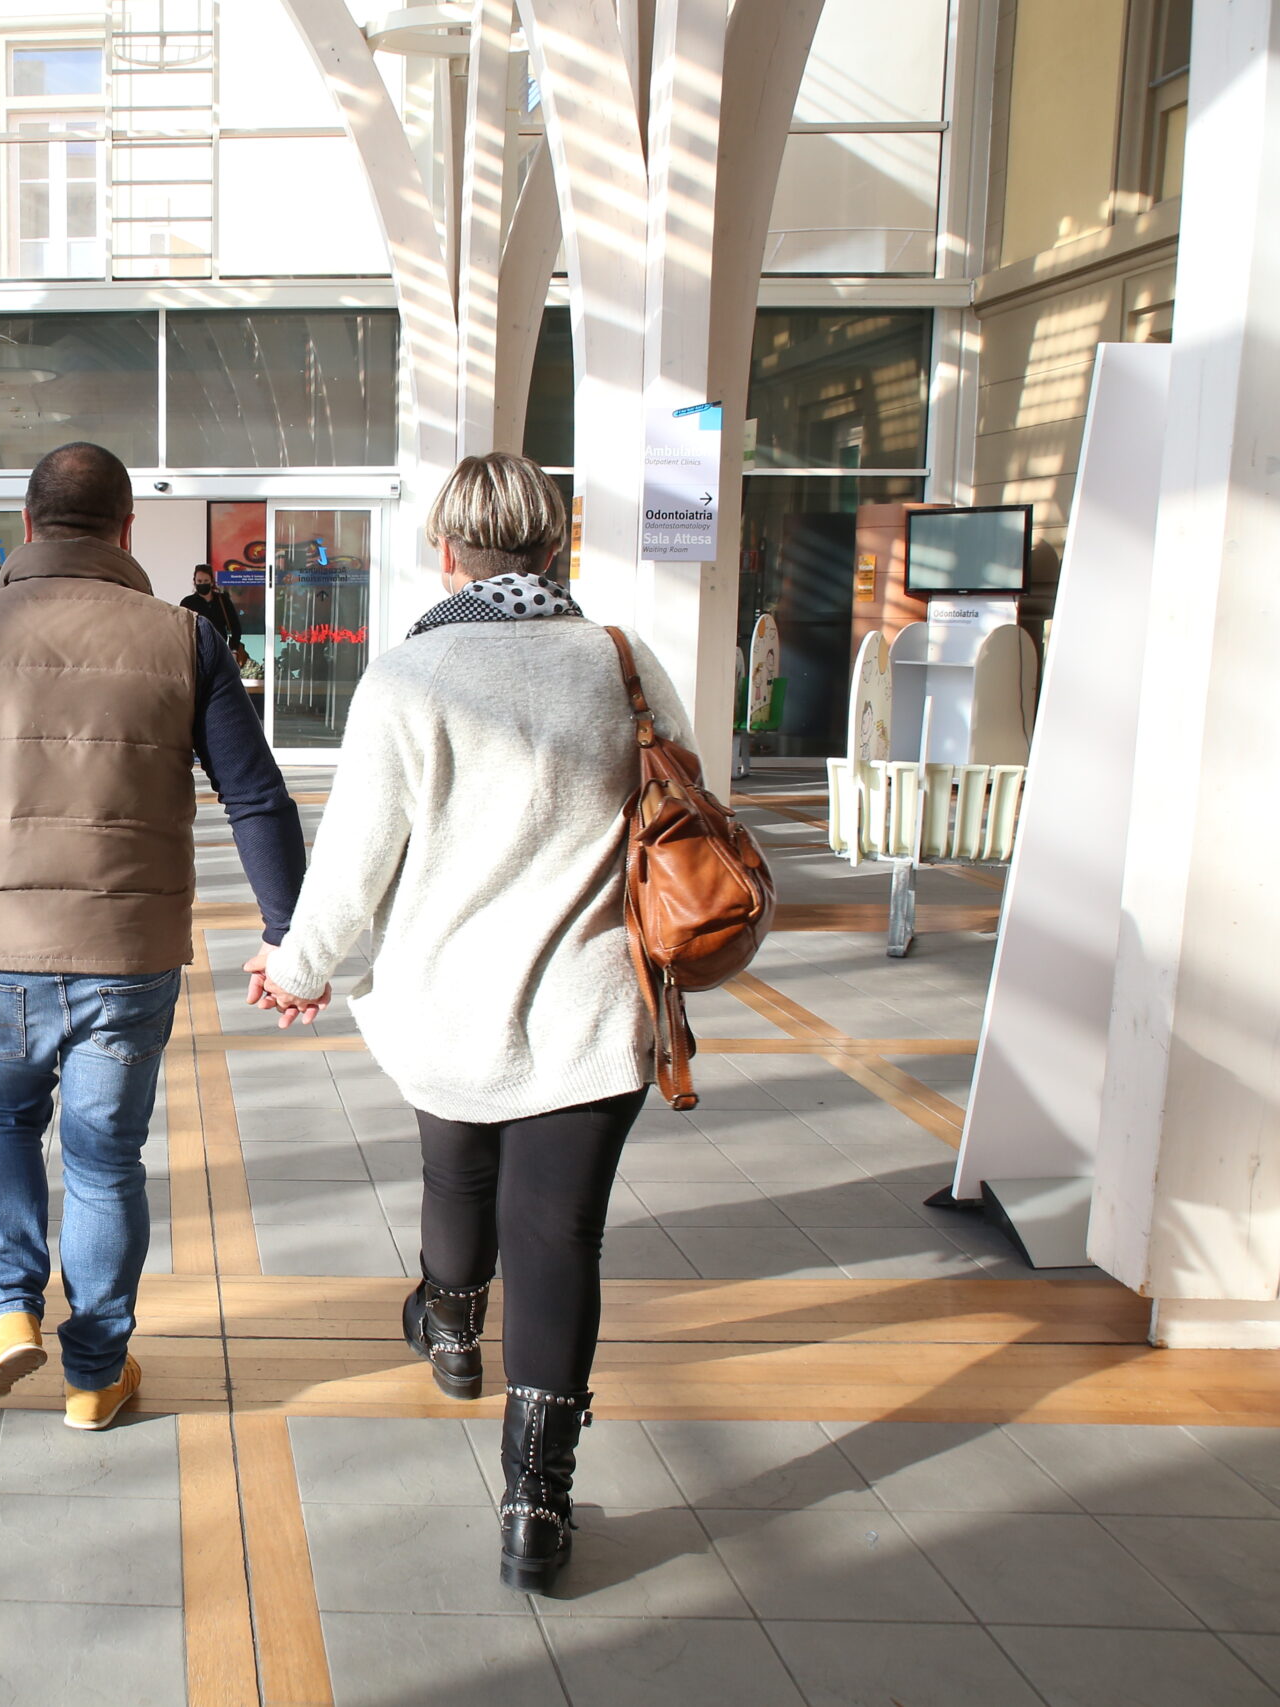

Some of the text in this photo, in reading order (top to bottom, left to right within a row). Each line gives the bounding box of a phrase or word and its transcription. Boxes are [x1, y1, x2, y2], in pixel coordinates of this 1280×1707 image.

[645, 444, 714, 457] Ambulato
[645, 458, 702, 467] Outpatient Clinics
[645, 509, 713, 520] Odontoiatria
[643, 532, 712, 545] Sala Attesa
[642, 546, 668, 555] Waiting
[933, 609, 979, 618] Odontoiatria
